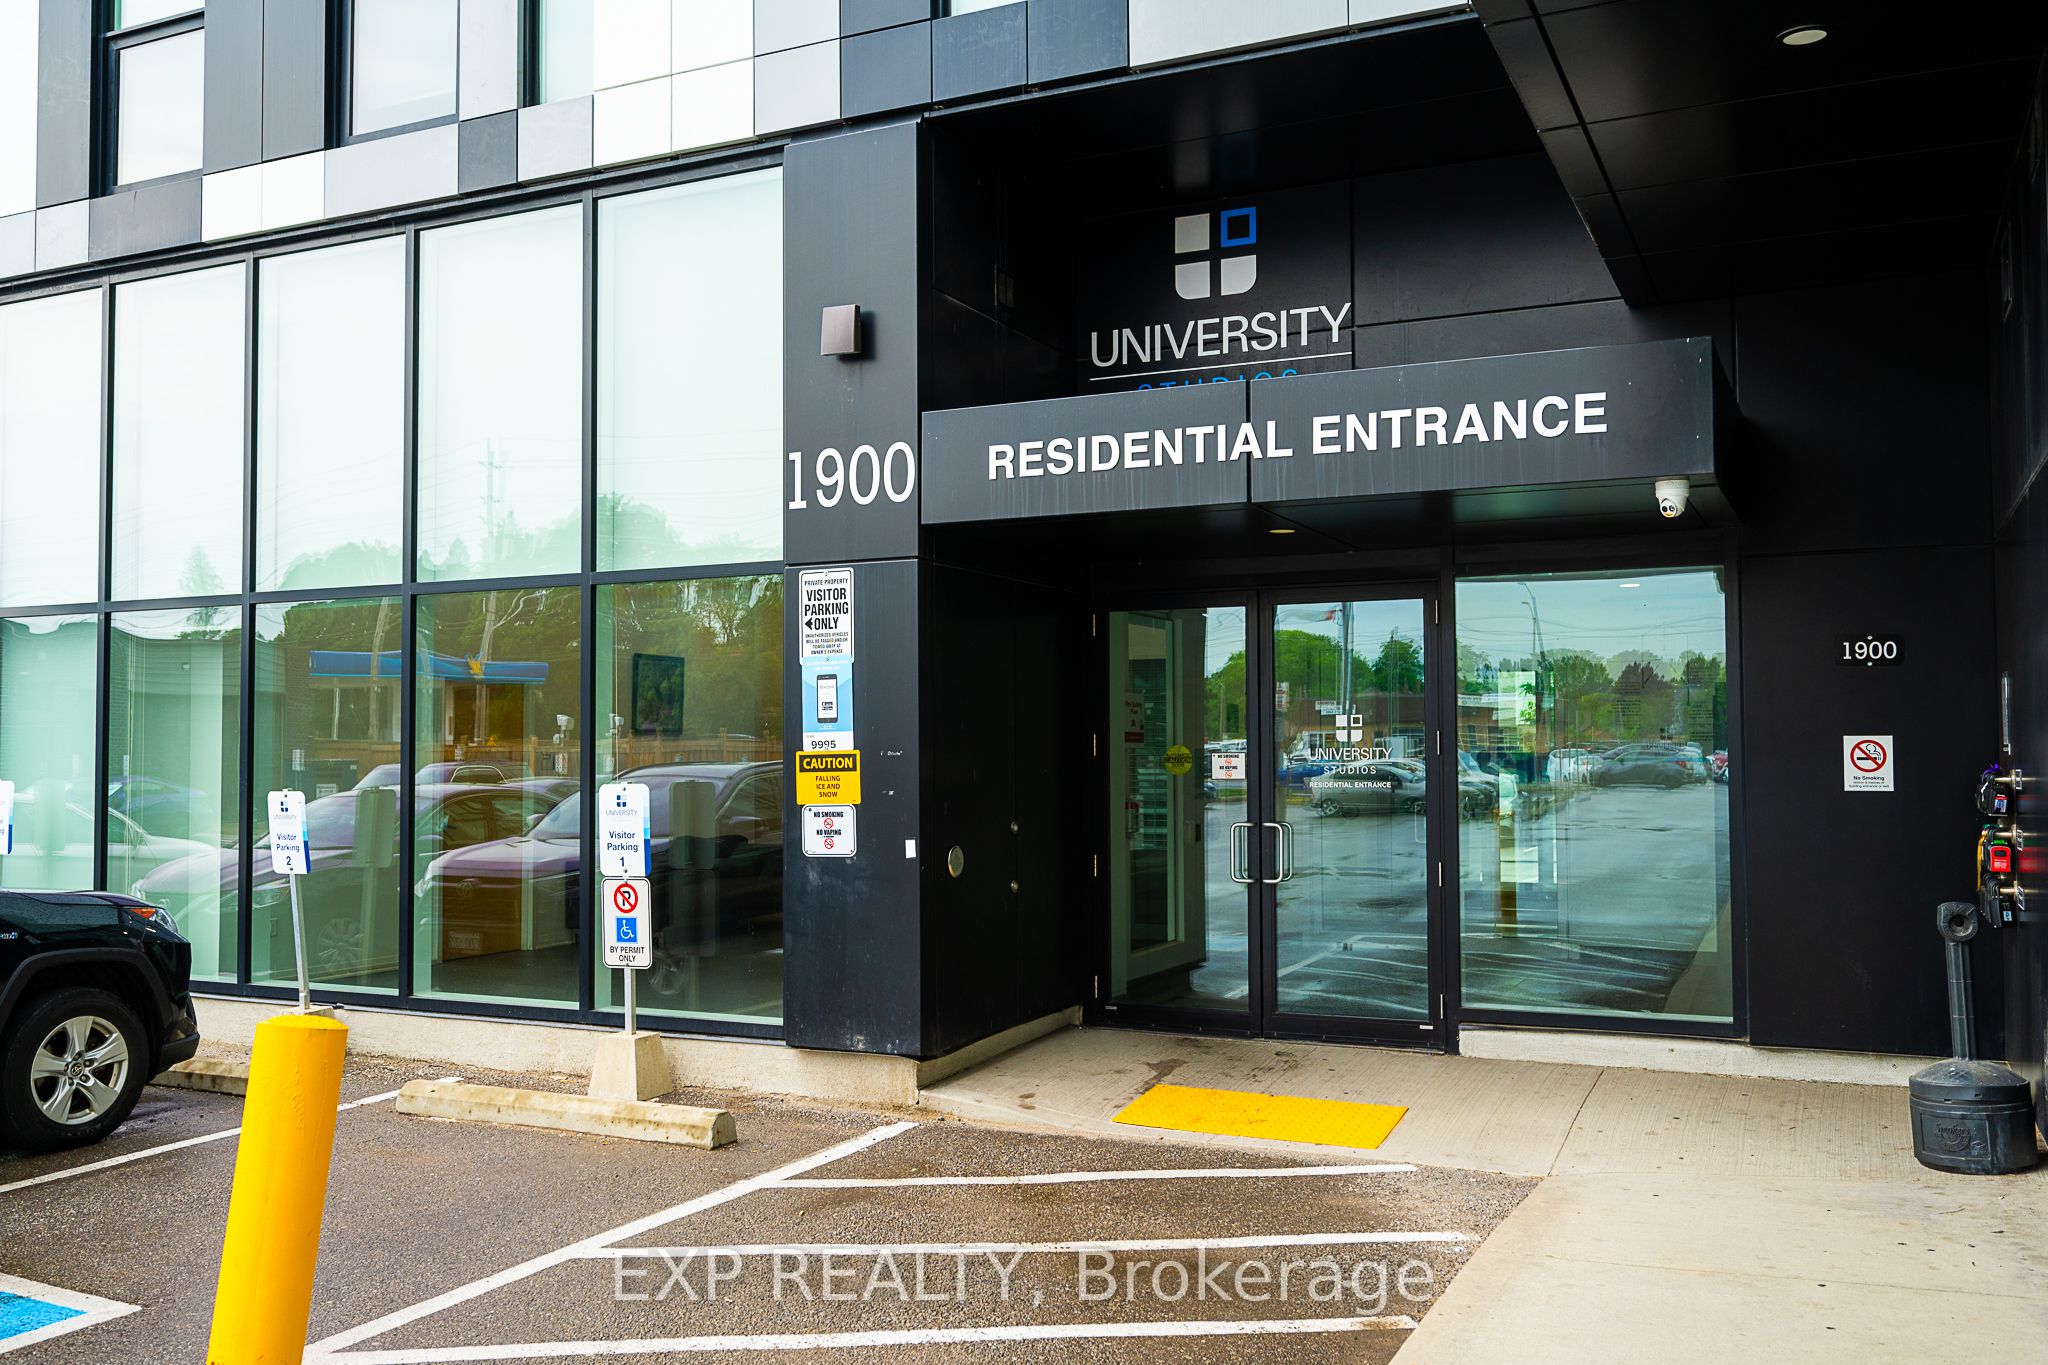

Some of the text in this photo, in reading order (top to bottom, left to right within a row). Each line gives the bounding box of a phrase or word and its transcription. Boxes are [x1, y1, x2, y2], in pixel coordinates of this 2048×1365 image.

[1091, 303, 1351, 367] UNIVERSITY
[988, 392, 1608, 480] RESIDENTIAL ENTRANCE
[788, 441, 915, 510] 1900
[806, 588, 846, 602] VISITOR
[804, 602, 848, 616] PARKING
[814, 616, 839, 630] ONLY
[1842, 641, 1897, 660] 1900
[811, 740, 836, 750] 9995
[1308, 747, 1392, 761] UNIVERSITY
[803, 757, 853, 770] CAUTION
[1324, 766, 1376, 774] STUDIOS
[277, 833, 297, 841] Visitor
[609, 830, 635, 839] Visitor
[276, 844, 300, 852] Parking
[607, 843, 639, 853] Parking
[286, 856, 292, 866] 2
[620, 857, 625, 867] 1
[620, 946, 645, 954] PERMIT
[619, 954, 636, 962] ONLY
